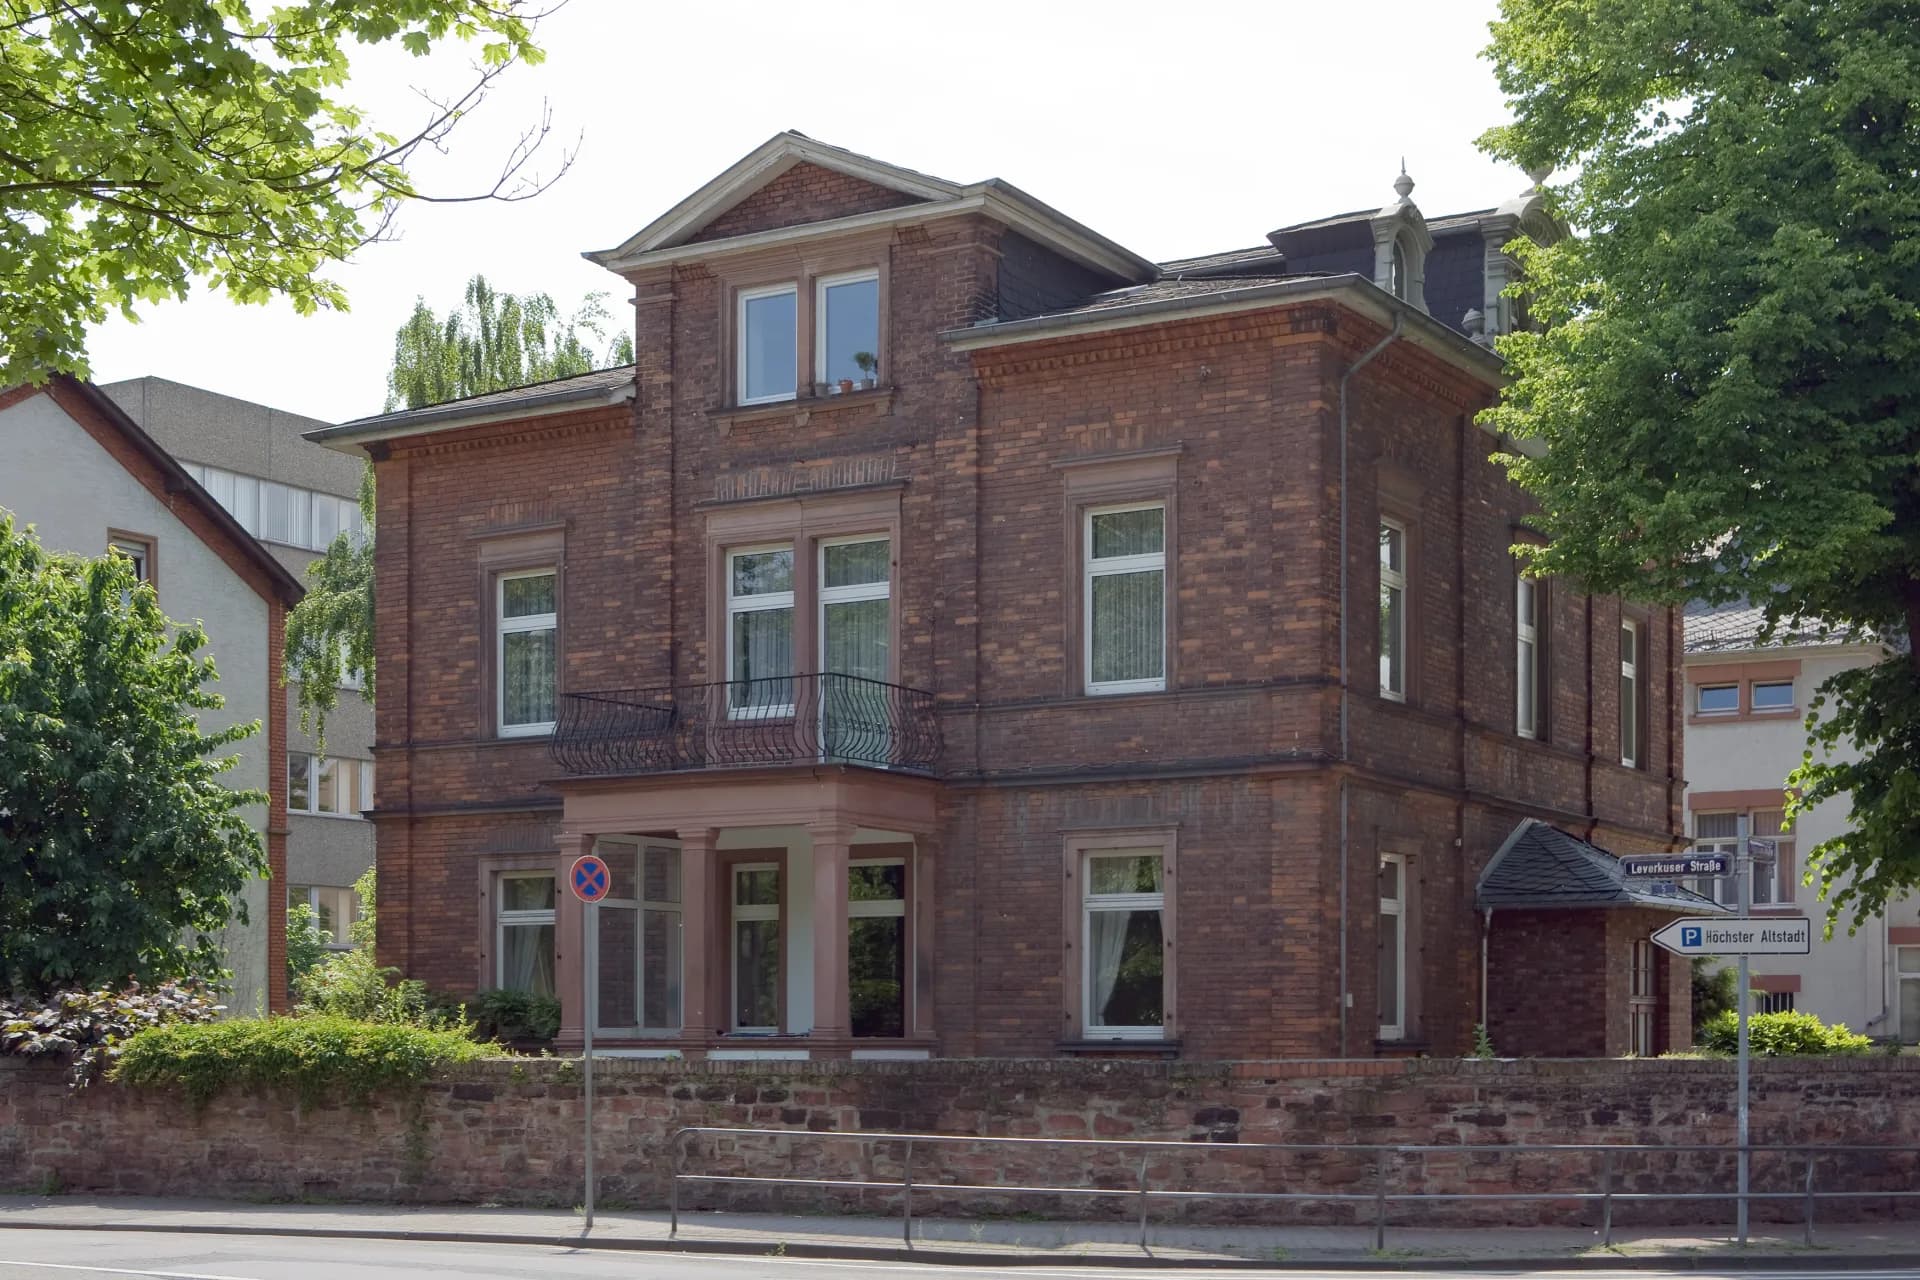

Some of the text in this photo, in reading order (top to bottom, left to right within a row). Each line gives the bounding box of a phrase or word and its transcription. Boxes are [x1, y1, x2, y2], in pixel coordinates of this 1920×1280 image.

[1631, 860, 1721, 874] Leverkuser Straße
[1685, 929, 1806, 945] P Höchster Altstadt
